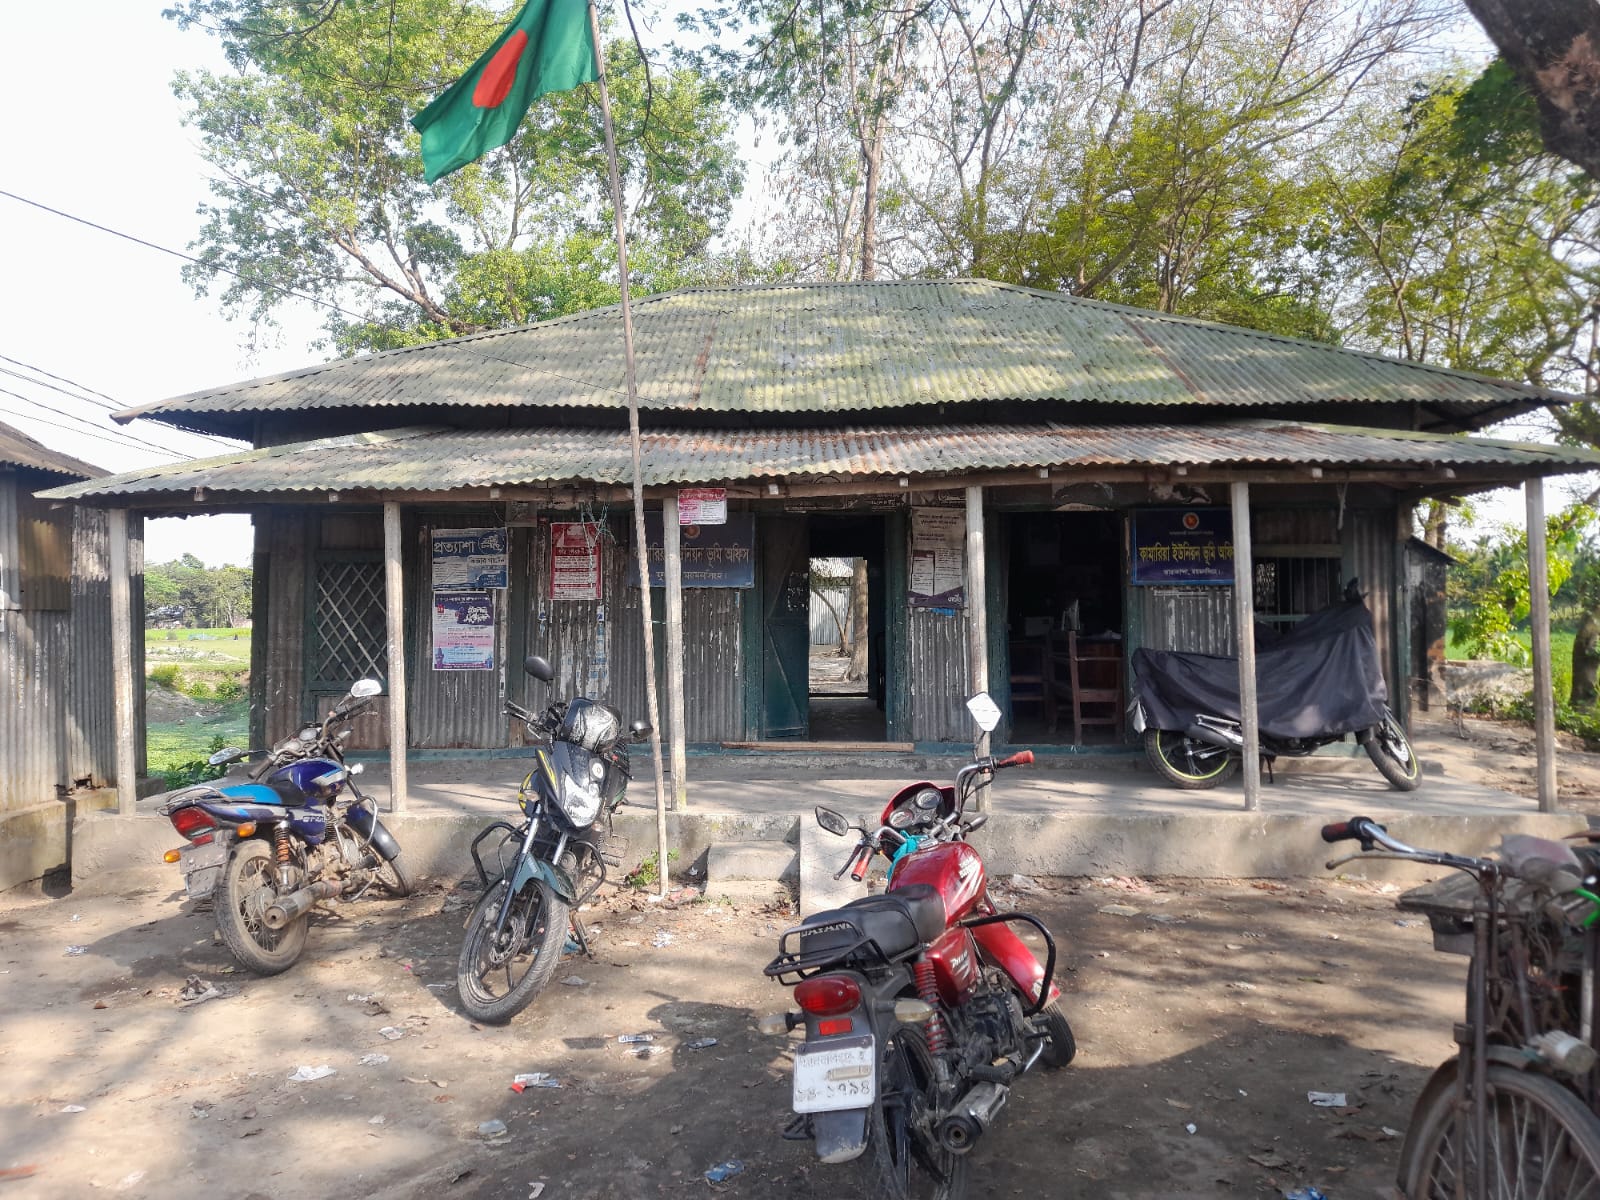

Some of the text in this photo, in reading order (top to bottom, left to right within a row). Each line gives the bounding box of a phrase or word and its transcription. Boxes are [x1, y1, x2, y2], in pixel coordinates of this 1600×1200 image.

[433, 540, 476, 555] প্রত্যাশা
[706, 542, 722, 568] ভূমি
[724, 542, 750, 564] অফিস
[1202, 541, 1216, 565] ভূমি
[1217, 541, 1234, 561] অফি
